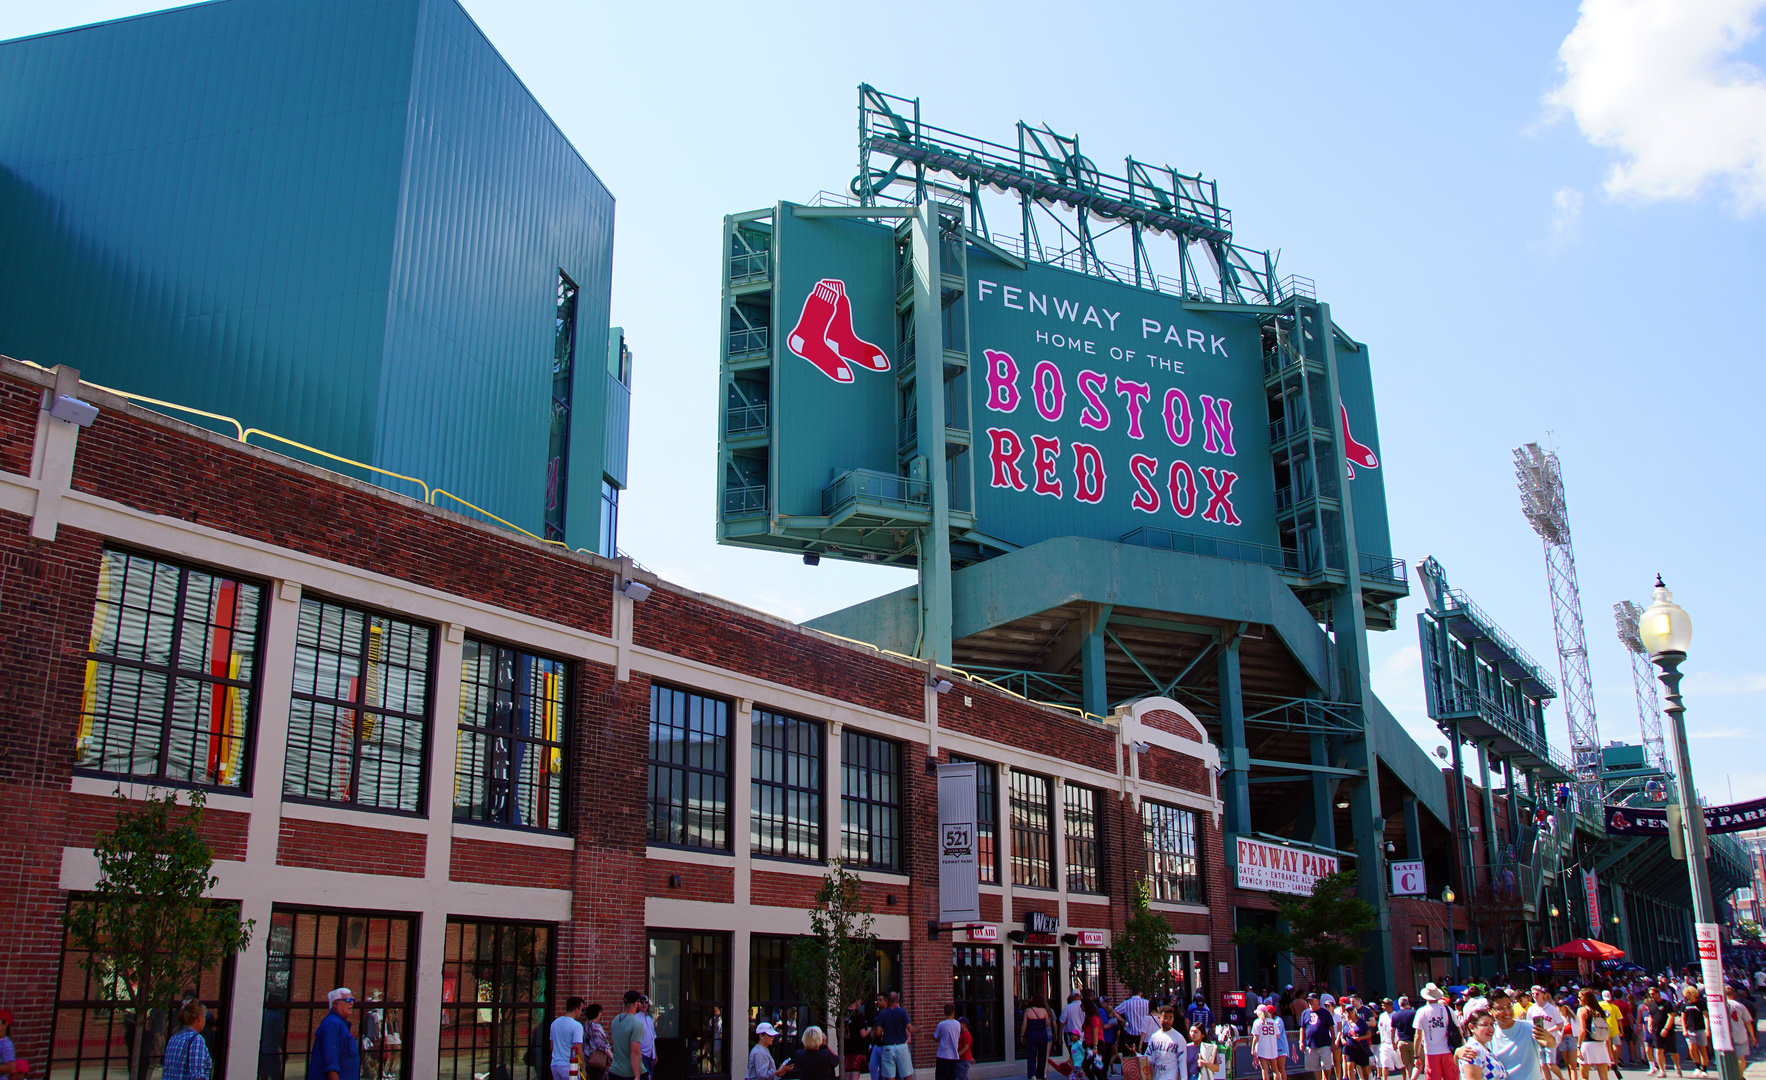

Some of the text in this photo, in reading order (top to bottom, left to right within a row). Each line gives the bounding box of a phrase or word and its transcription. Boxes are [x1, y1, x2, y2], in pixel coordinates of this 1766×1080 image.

[978, 279, 1228, 358] FENWAY PARK
[1036, 330, 1185, 374] HOME OF THE
[983, 349, 1236, 457] BOSTON
[986, 427, 1242, 526] RED SOX
[1636, 815, 1715, 829] FENY
[946, 830, 968, 846] 521
[1238, 840, 1336, 878] FENWAY PARK
[1393, 863, 1421, 871] GATE
[1239, 866, 1255, 876] GATE
[1271, 871, 1299, 883] ENTRANCE
[1400, 872, 1416, 891] C
[1586, 877, 1594, 890] BAR
[1239, 875, 1313, 893] IPSWICH STREET LANSDO
[1587, 892, 1599, 927] BLEACHER
[984, 928, 996, 937] AIR
[1262, 1025, 1275, 1036] 99
